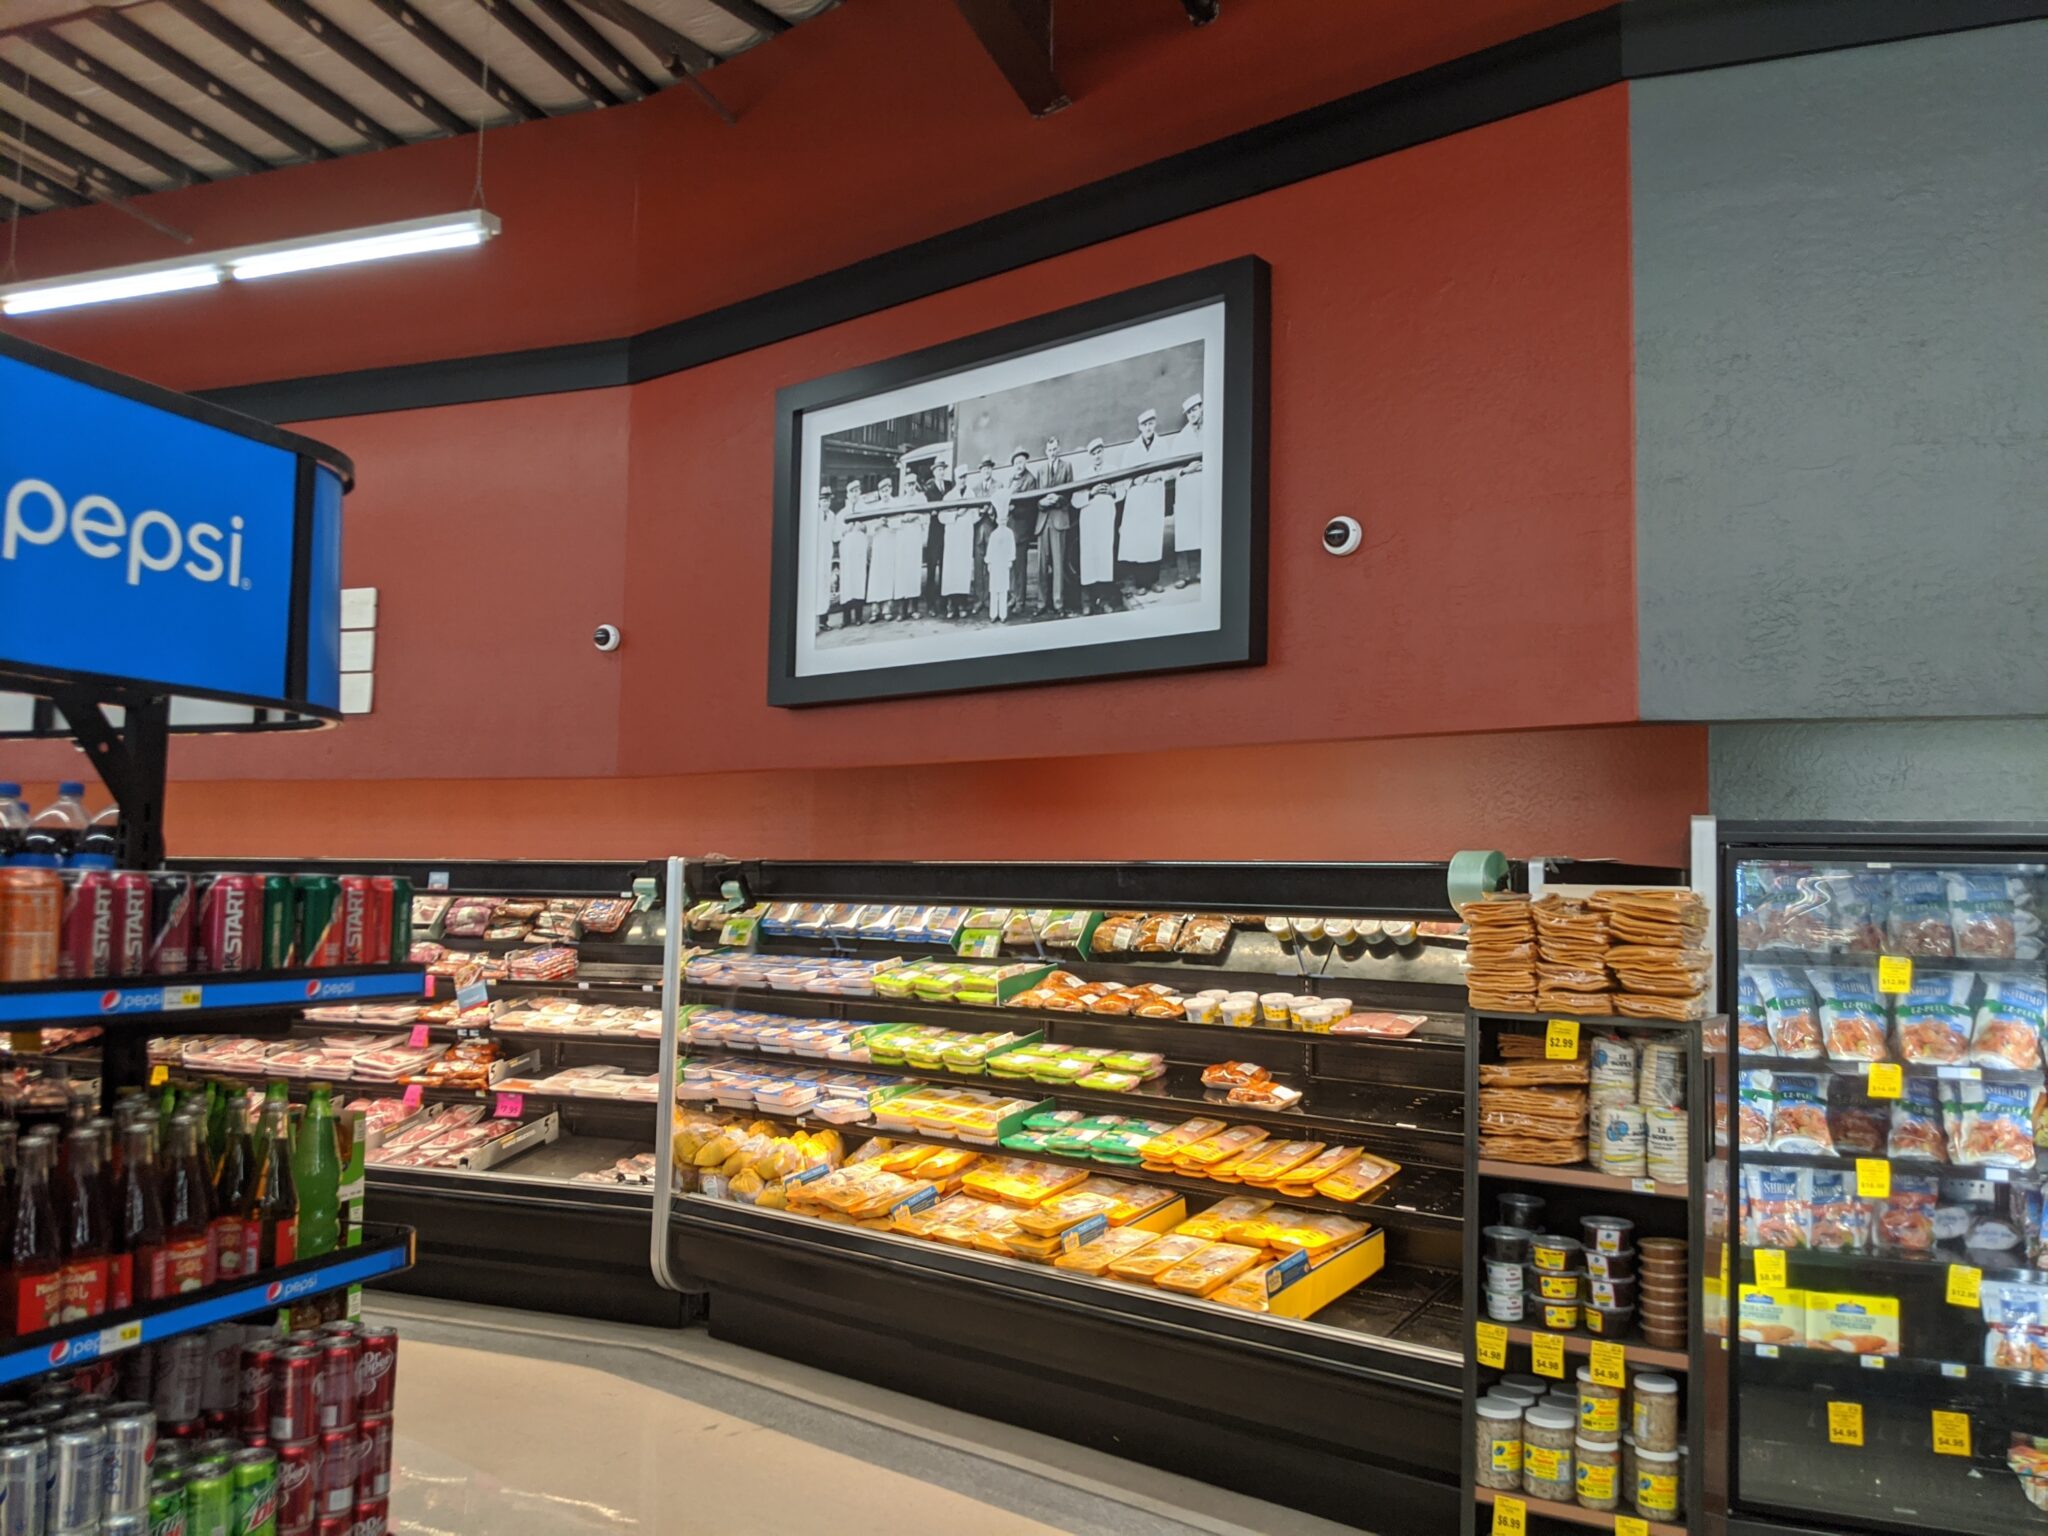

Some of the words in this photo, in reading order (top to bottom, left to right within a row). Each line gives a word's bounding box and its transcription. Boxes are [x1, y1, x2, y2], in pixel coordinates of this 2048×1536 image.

[2, 478, 244, 587] pepsi
[123, 993, 162, 1009] peps
[1550, 1037, 1574, 1049] $2.99
[1497, 1514, 1521, 1530] $6.99
